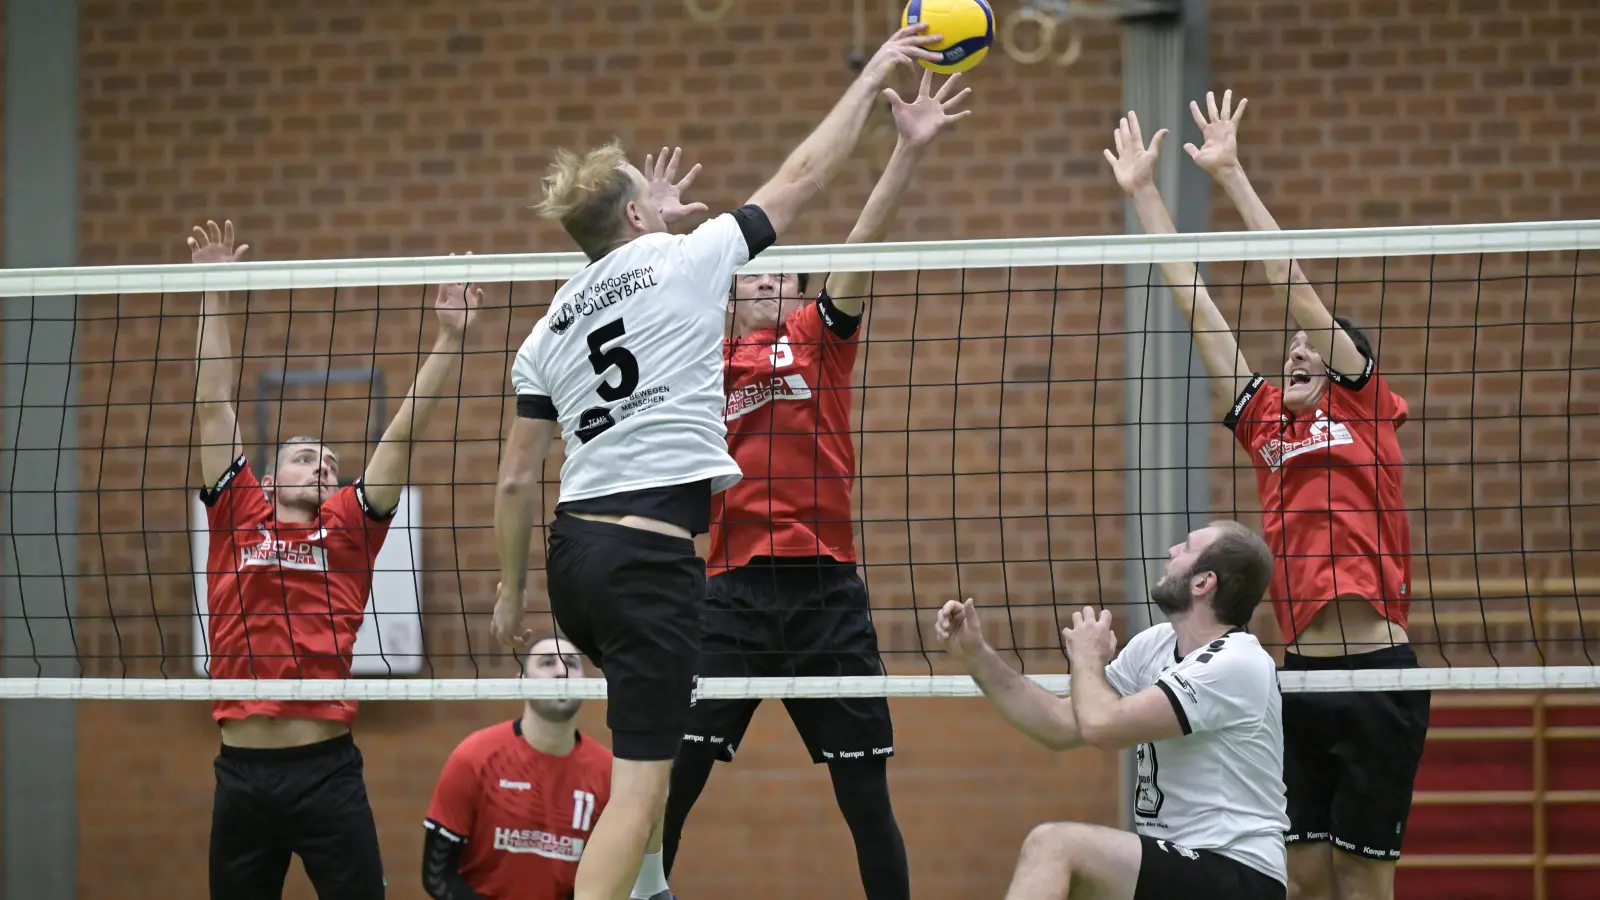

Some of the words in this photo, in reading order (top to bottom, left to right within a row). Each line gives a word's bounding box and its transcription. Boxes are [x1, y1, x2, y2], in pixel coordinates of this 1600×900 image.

[586, 316, 640, 403] 5
[629, 385, 670, 401] BEWEGEN
[621, 395, 665, 412] MENSCHEN
[839, 750, 865, 759] Kempa
[572, 789, 595, 831] 11
[1335, 836, 1356, 851] Kempa
[1363, 846, 1386, 858] Kempa
